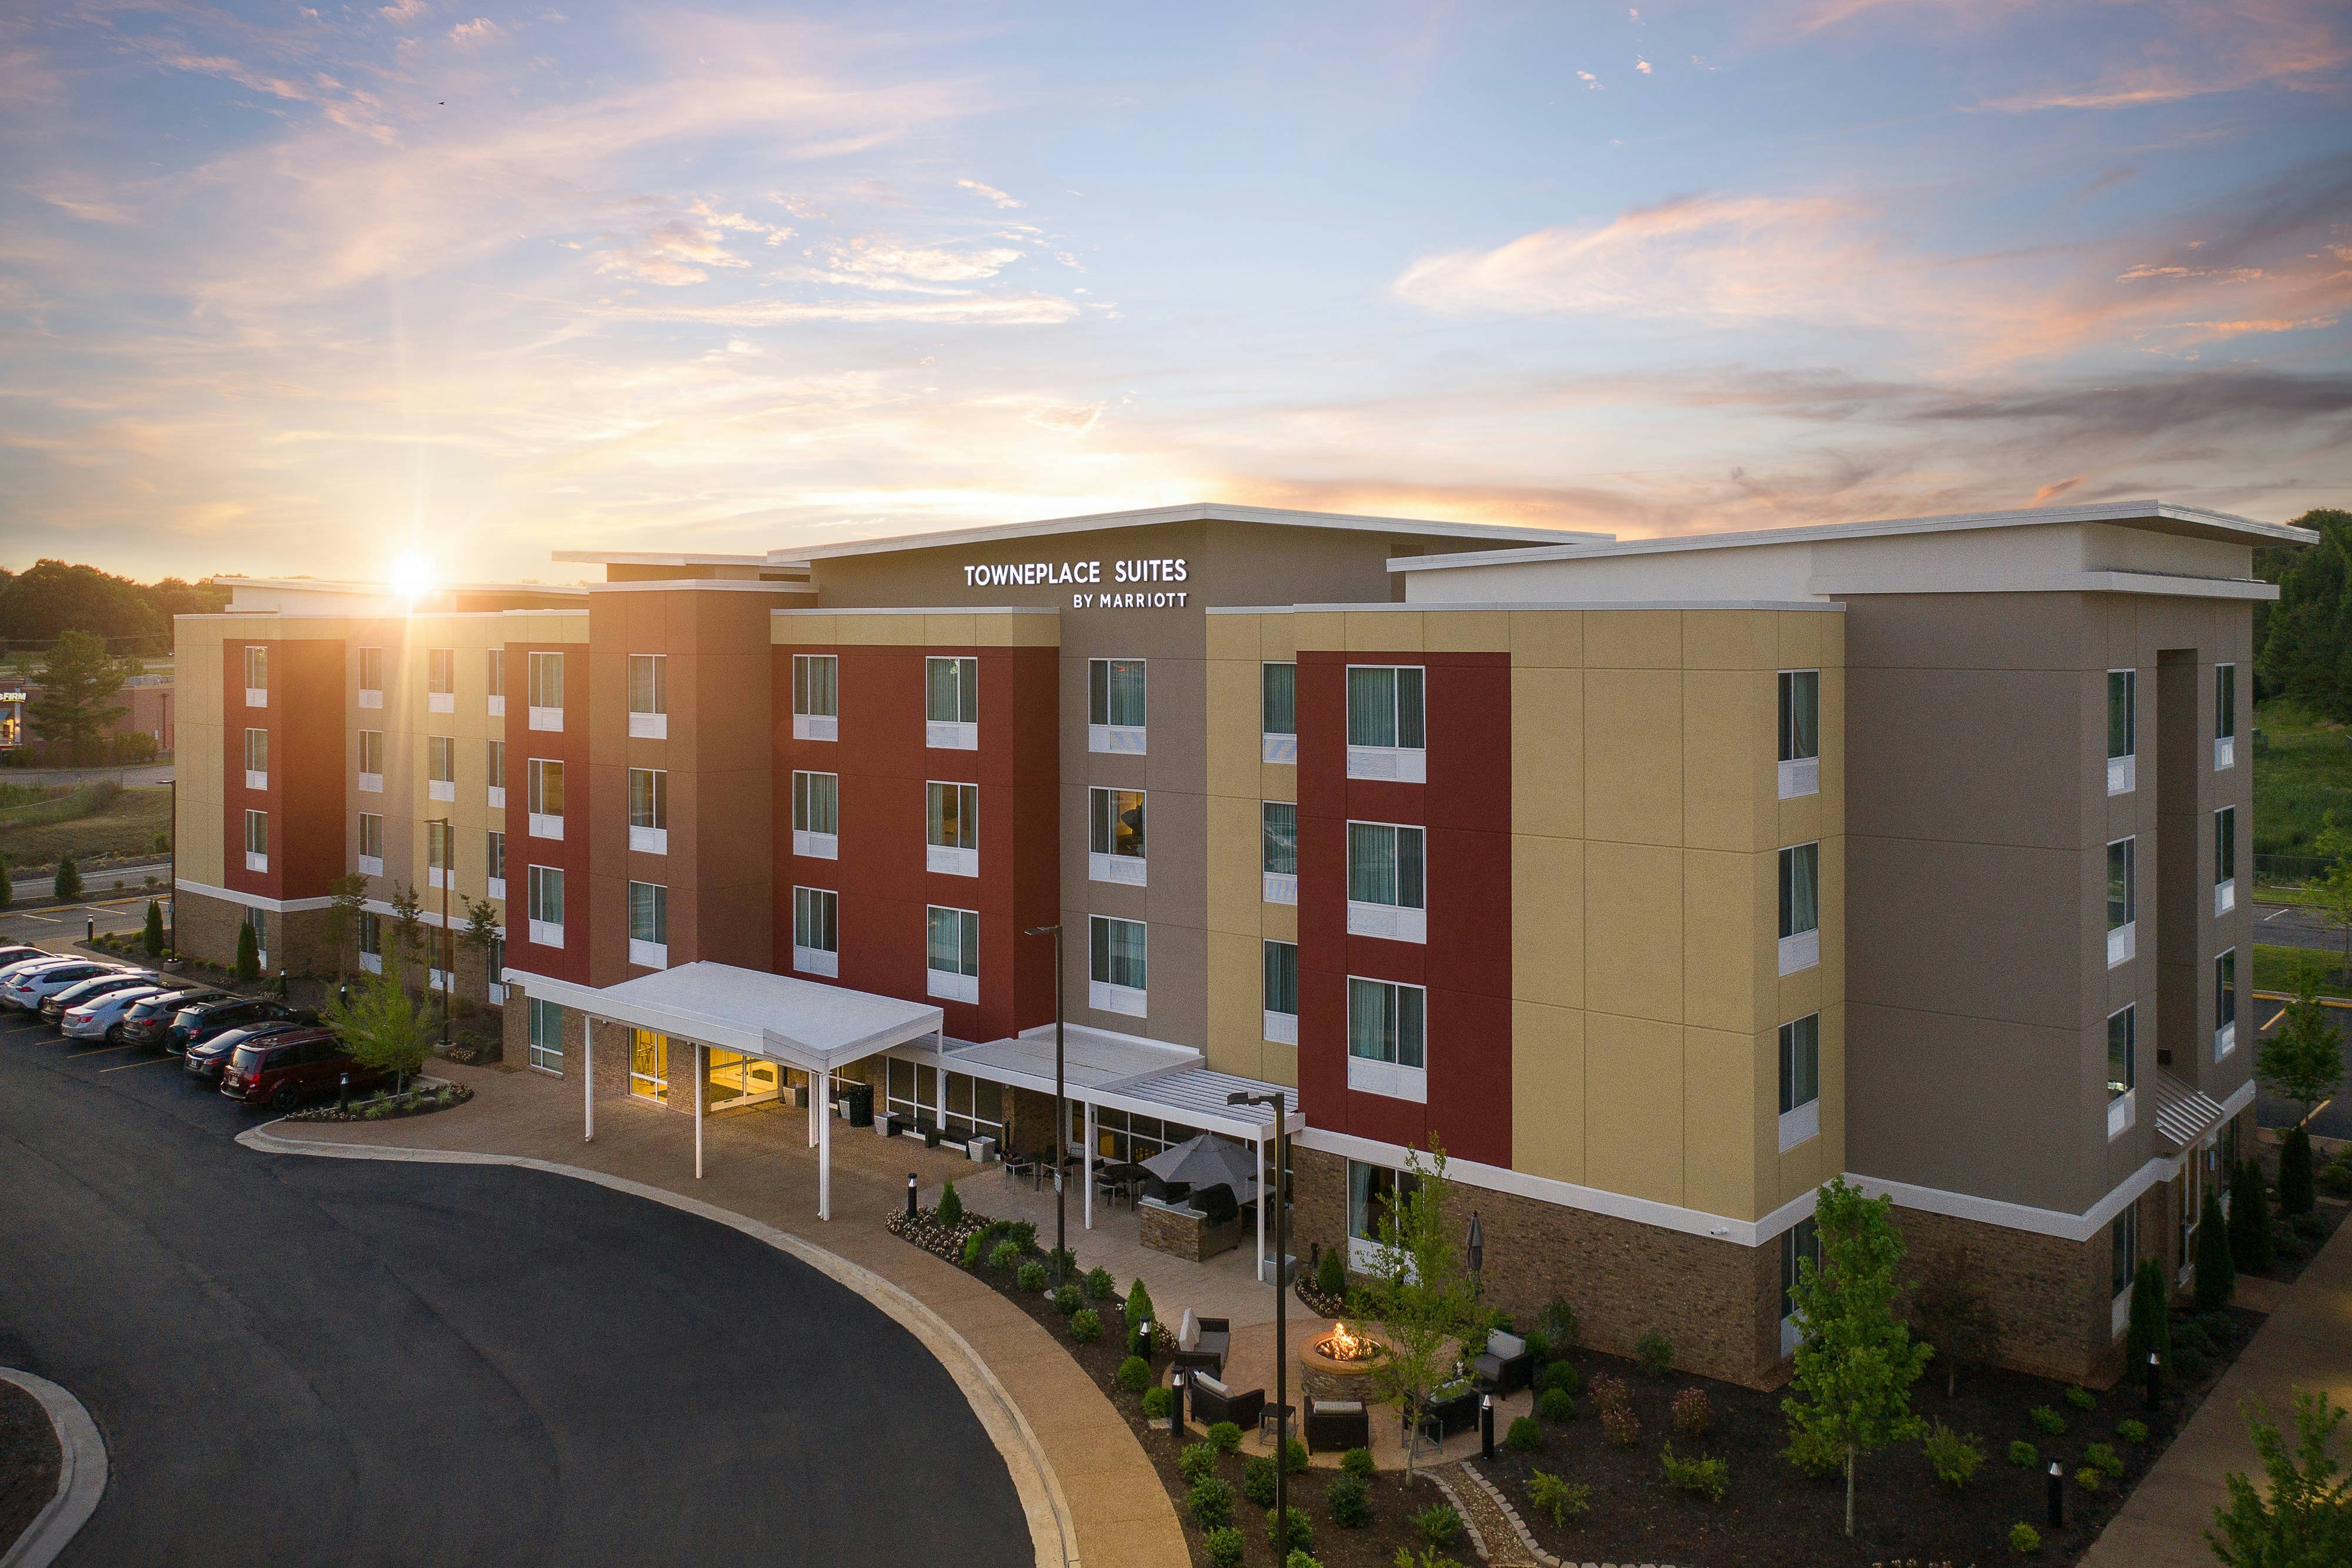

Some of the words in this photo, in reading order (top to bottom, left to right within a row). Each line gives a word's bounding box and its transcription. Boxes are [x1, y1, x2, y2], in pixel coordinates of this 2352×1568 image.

[964, 561, 1101, 586] TOWNEPLACE
[1114, 559, 1188, 583] SUITES
[1073, 594, 1093, 608] BY
[1100, 593, 1187, 608] MARRIOTT
